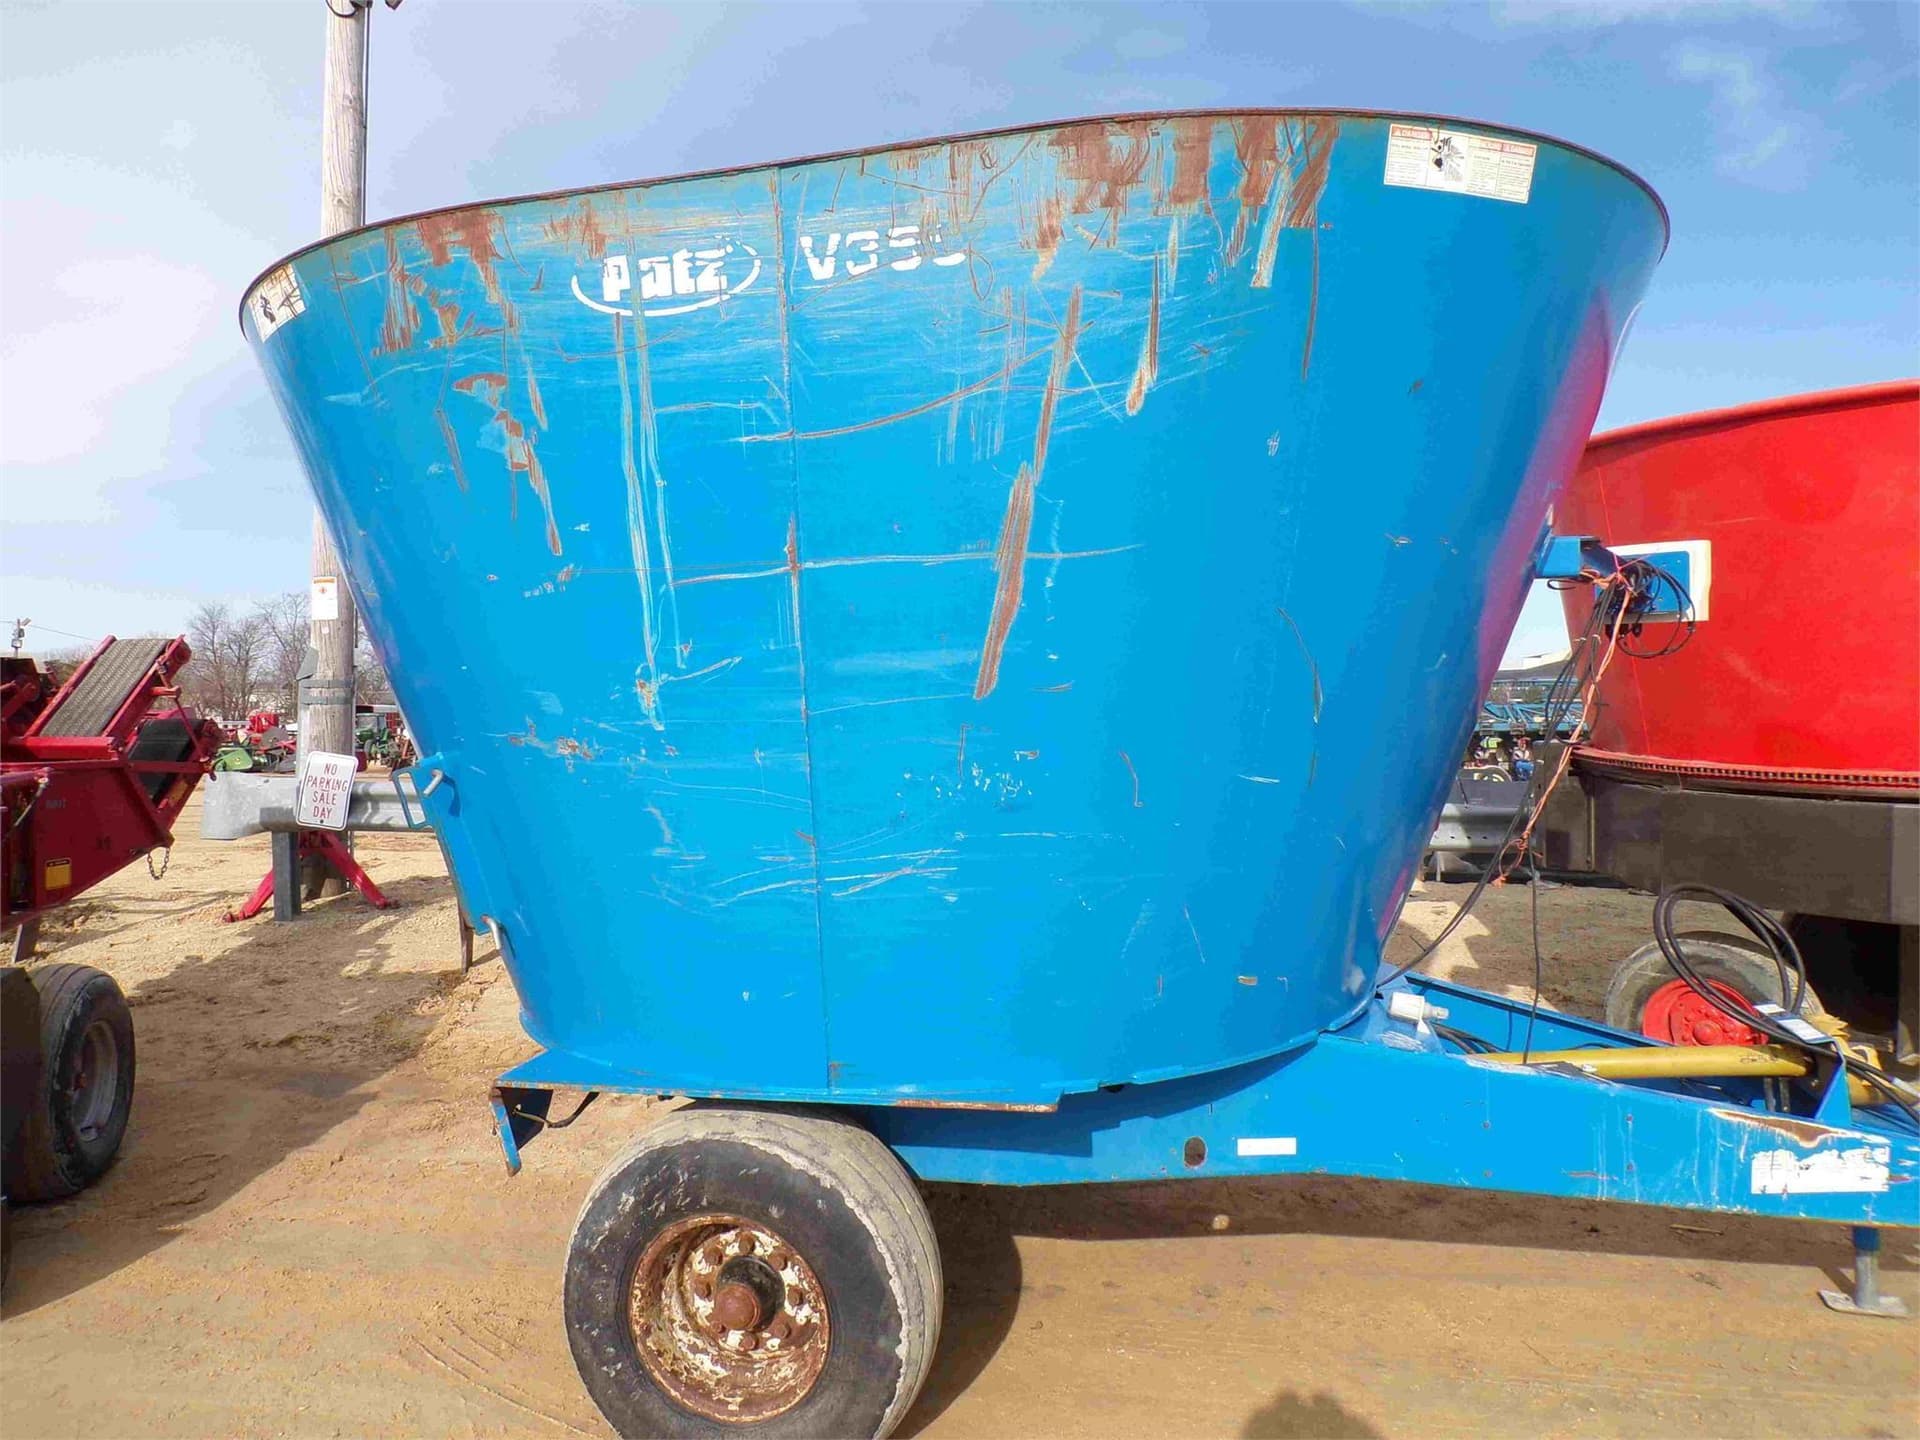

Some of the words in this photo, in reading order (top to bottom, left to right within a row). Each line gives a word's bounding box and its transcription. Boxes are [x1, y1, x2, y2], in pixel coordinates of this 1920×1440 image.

[602, 248, 728, 301] Patz
[323, 763, 338, 776] NO
[306, 775, 349, 793] PARKING
[312, 790, 337, 806] SALE
[312, 806, 333, 819] DAY
